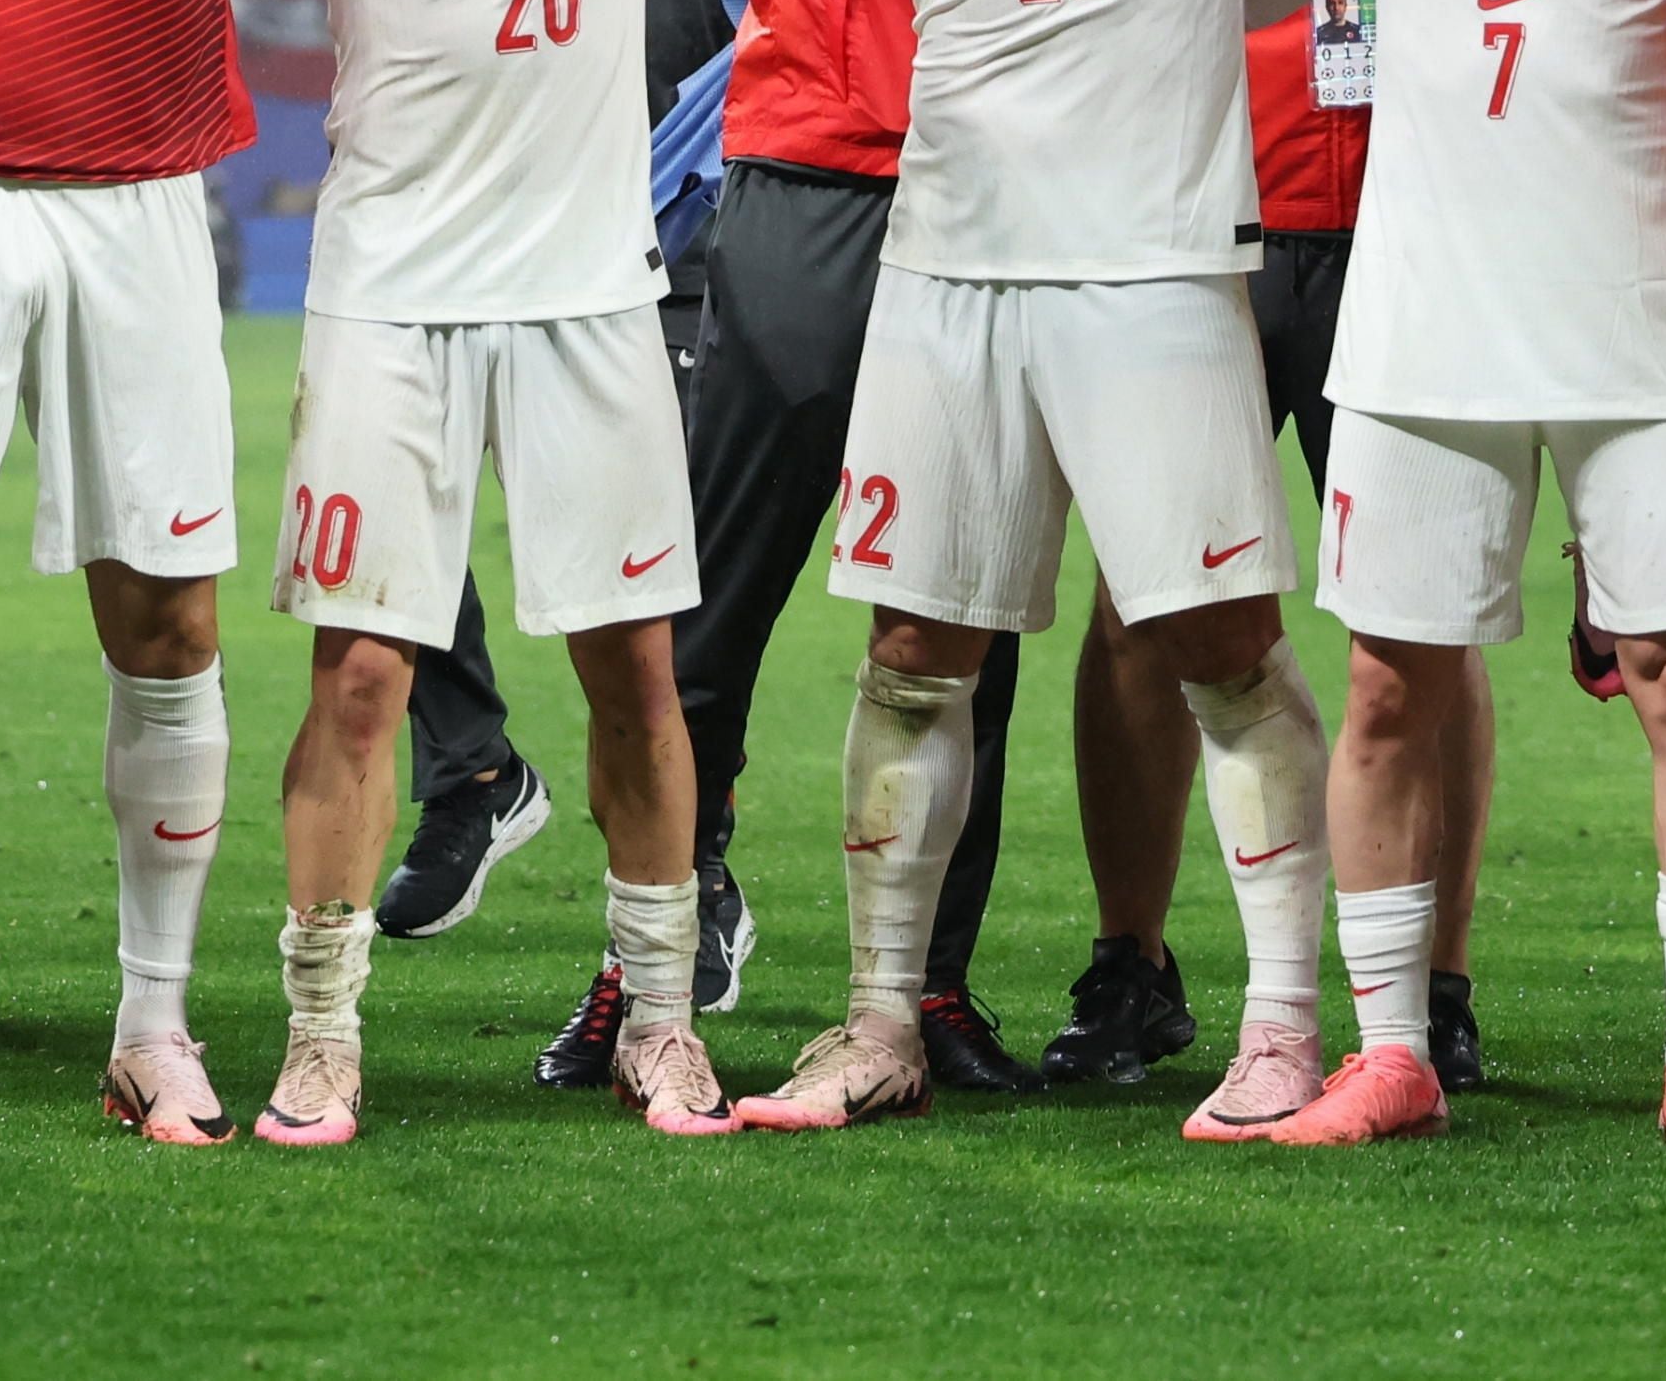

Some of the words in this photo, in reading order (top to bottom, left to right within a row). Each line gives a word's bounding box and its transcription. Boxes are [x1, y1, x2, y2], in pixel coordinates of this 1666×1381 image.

[1322, 48, 1331, 61] 0
[1344, 47, 1352, 59] 1
[1483, 22, 1527, 120] 7
[292, 483, 363, 591] 20
[1332, 488, 1354, 584] 7
